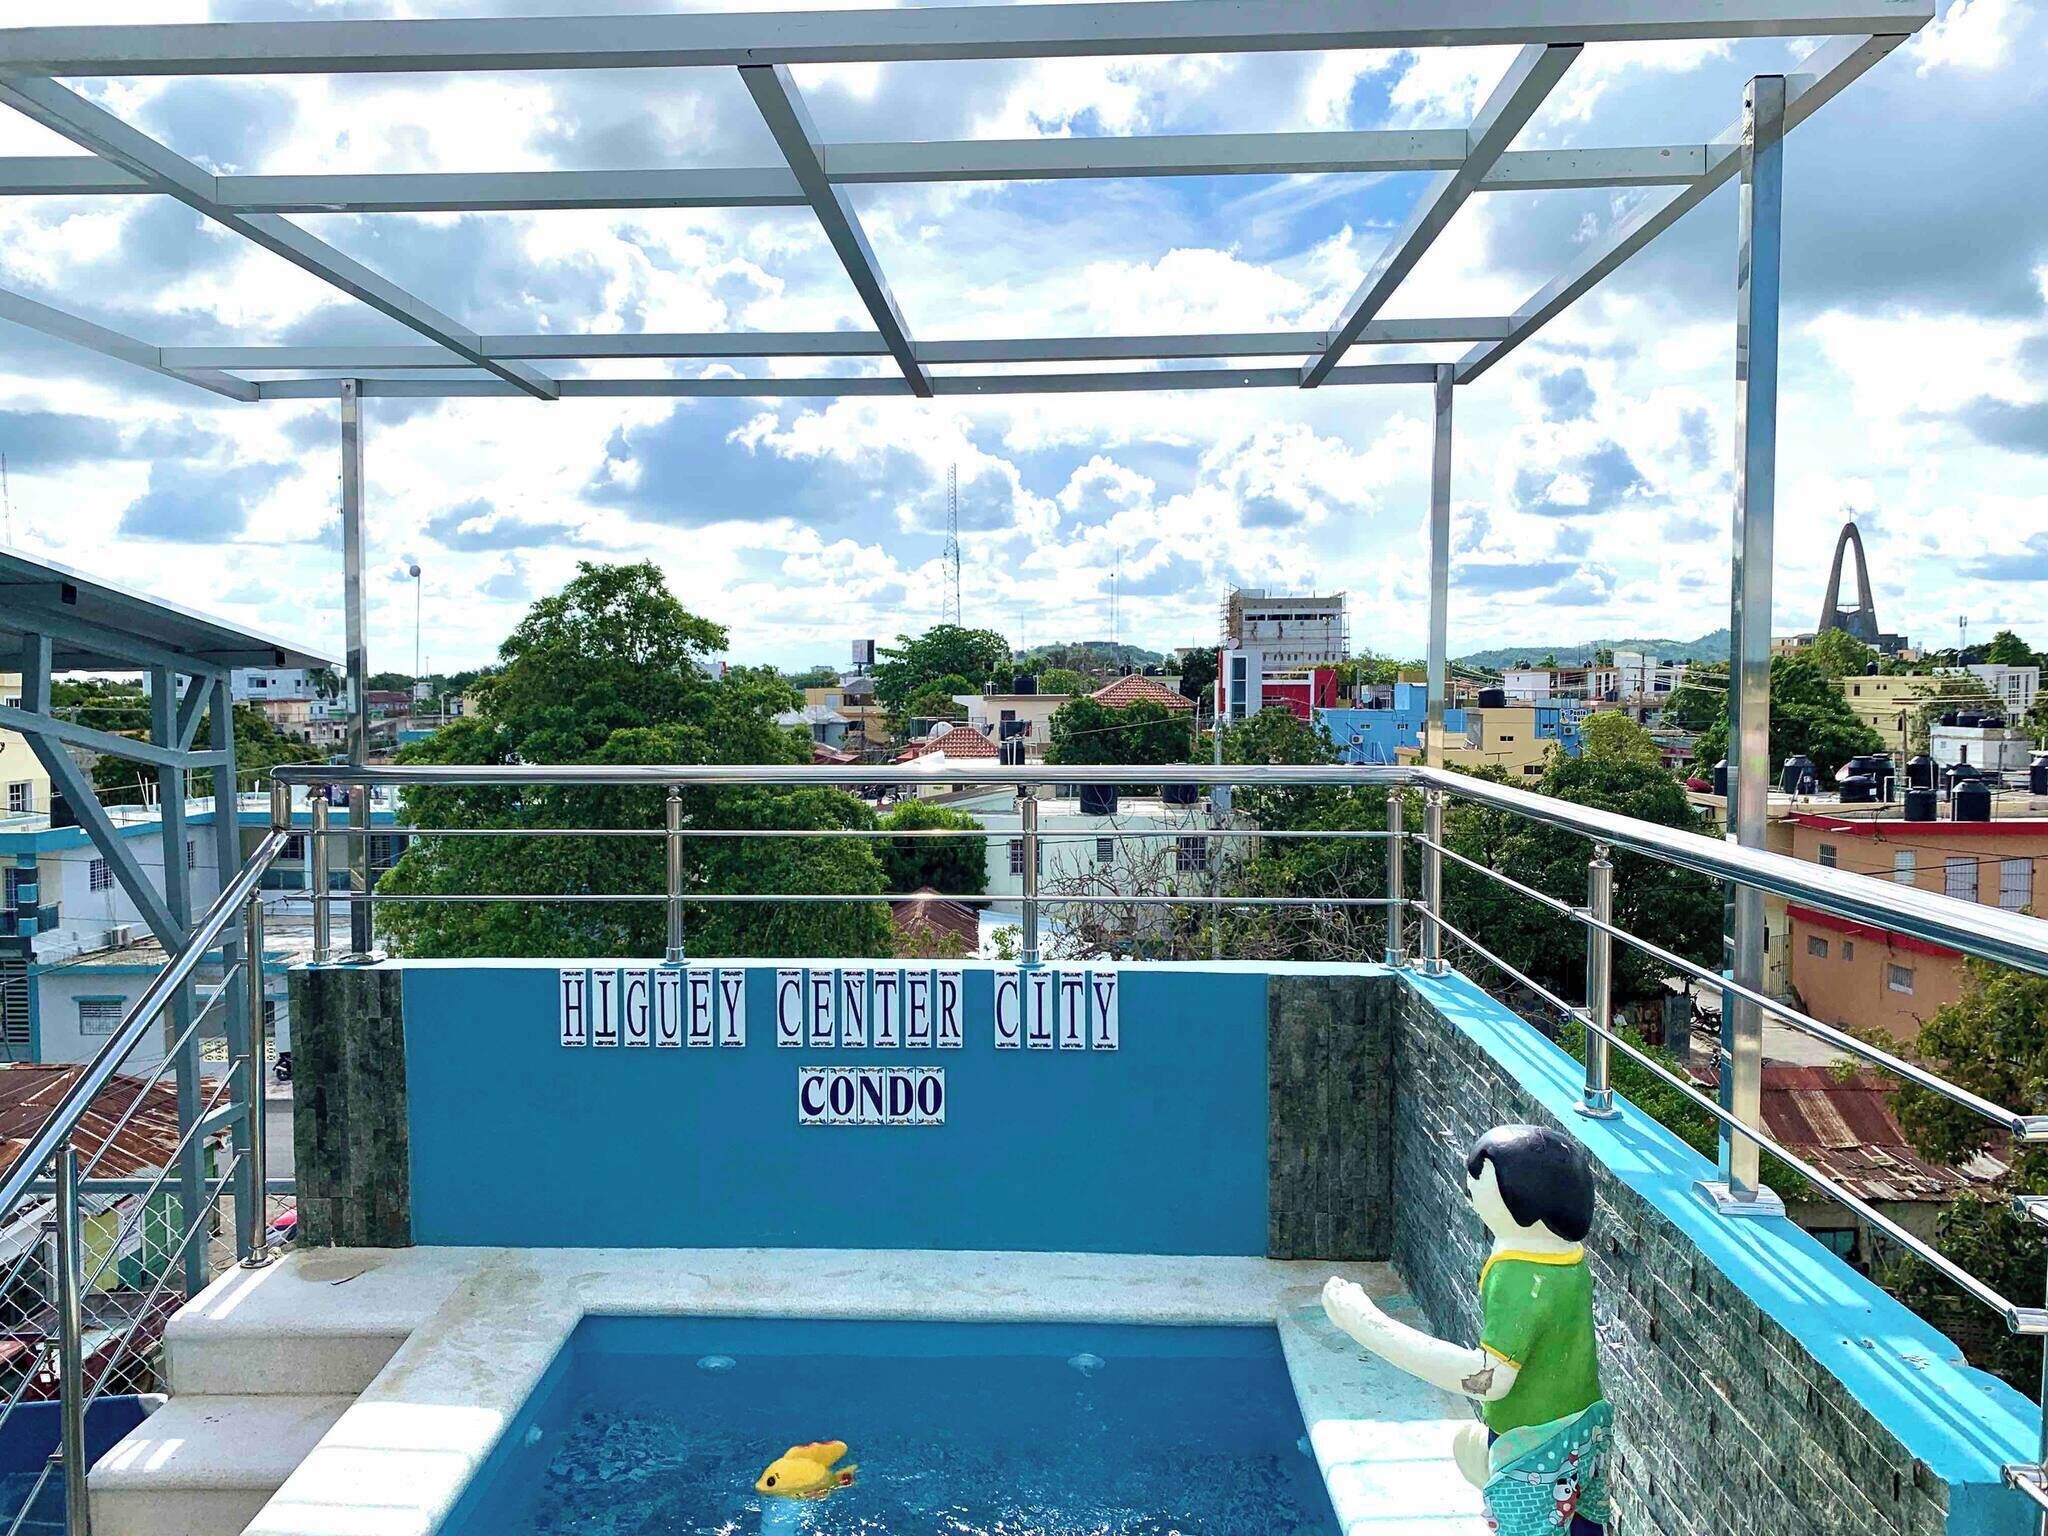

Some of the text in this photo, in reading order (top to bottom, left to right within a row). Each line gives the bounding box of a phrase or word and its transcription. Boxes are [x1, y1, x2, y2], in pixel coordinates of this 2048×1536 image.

[562, 979, 743, 1039] HIGUEY
[996, 980, 1116, 1040] CITY
[800, 1075, 943, 1117] CONDO
